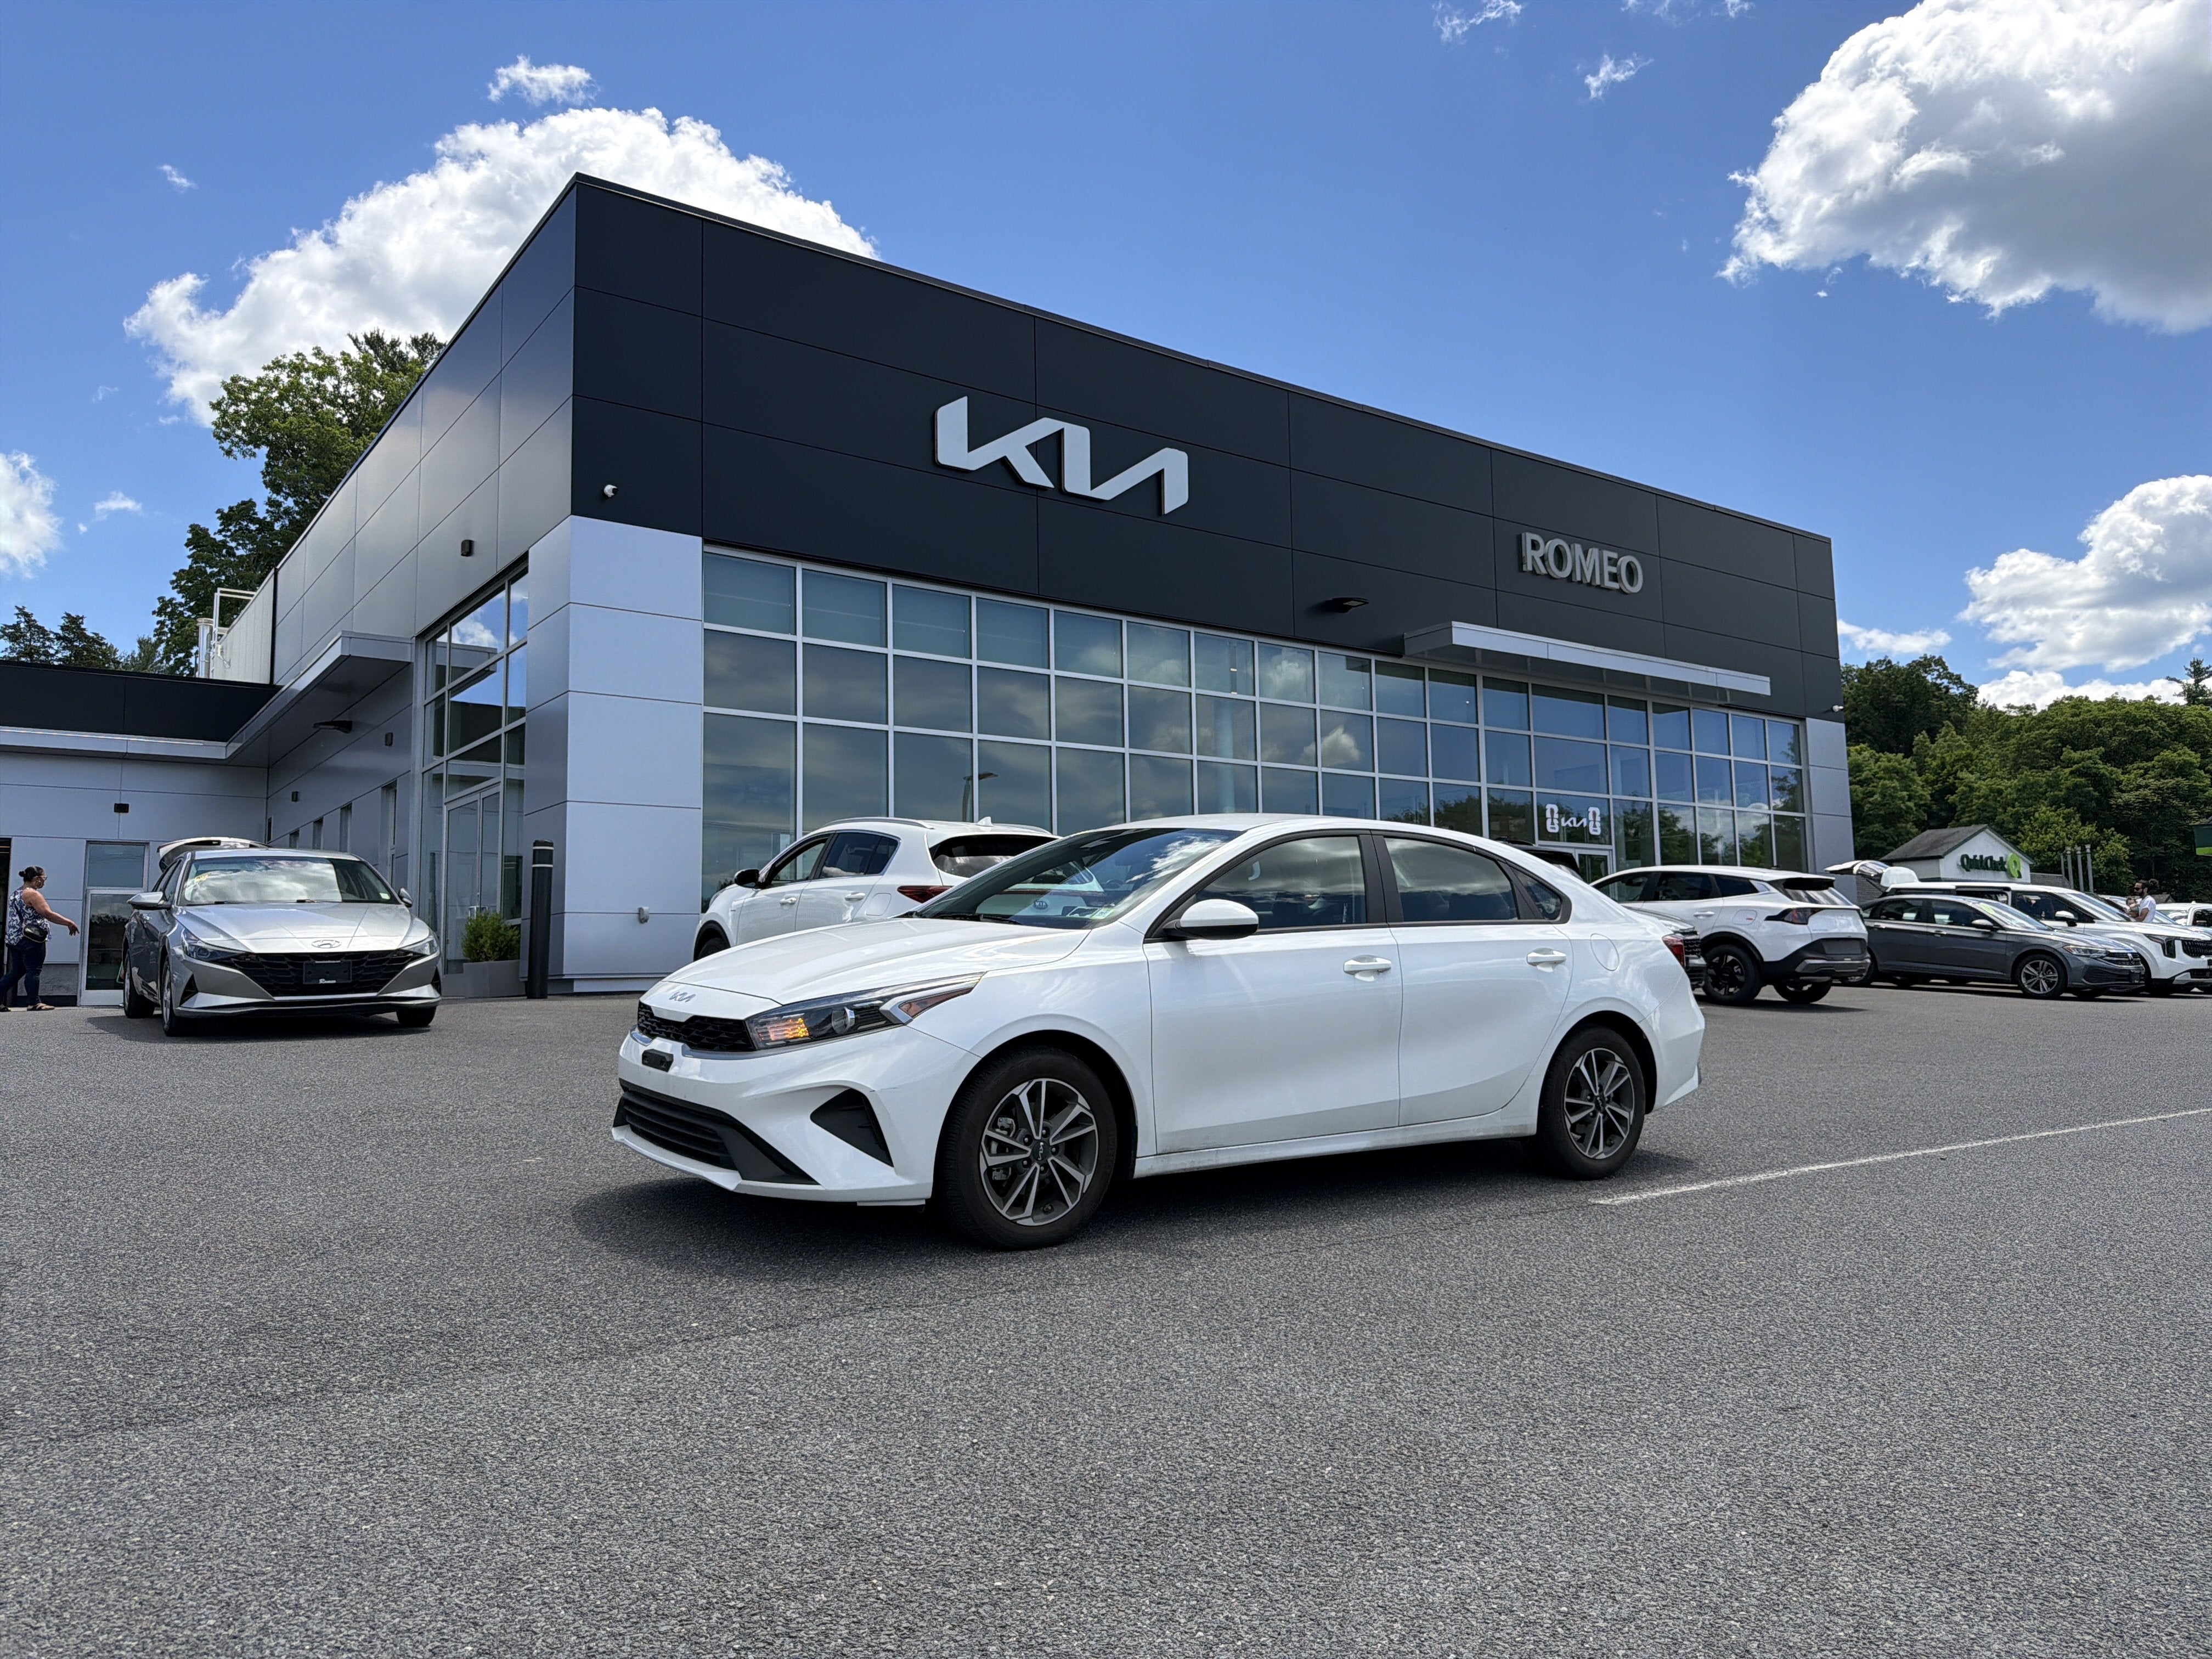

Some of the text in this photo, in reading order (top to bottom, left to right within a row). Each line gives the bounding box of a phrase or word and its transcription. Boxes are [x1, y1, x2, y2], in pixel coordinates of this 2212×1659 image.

[935, 396, 1188, 515] KIA
[1520, 531, 1644, 594] ROMEO
[1561, 816, 1587, 827] KIA
[1035, 900, 1048, 909] KIA
[669, 991, 696, 1003] KIA
